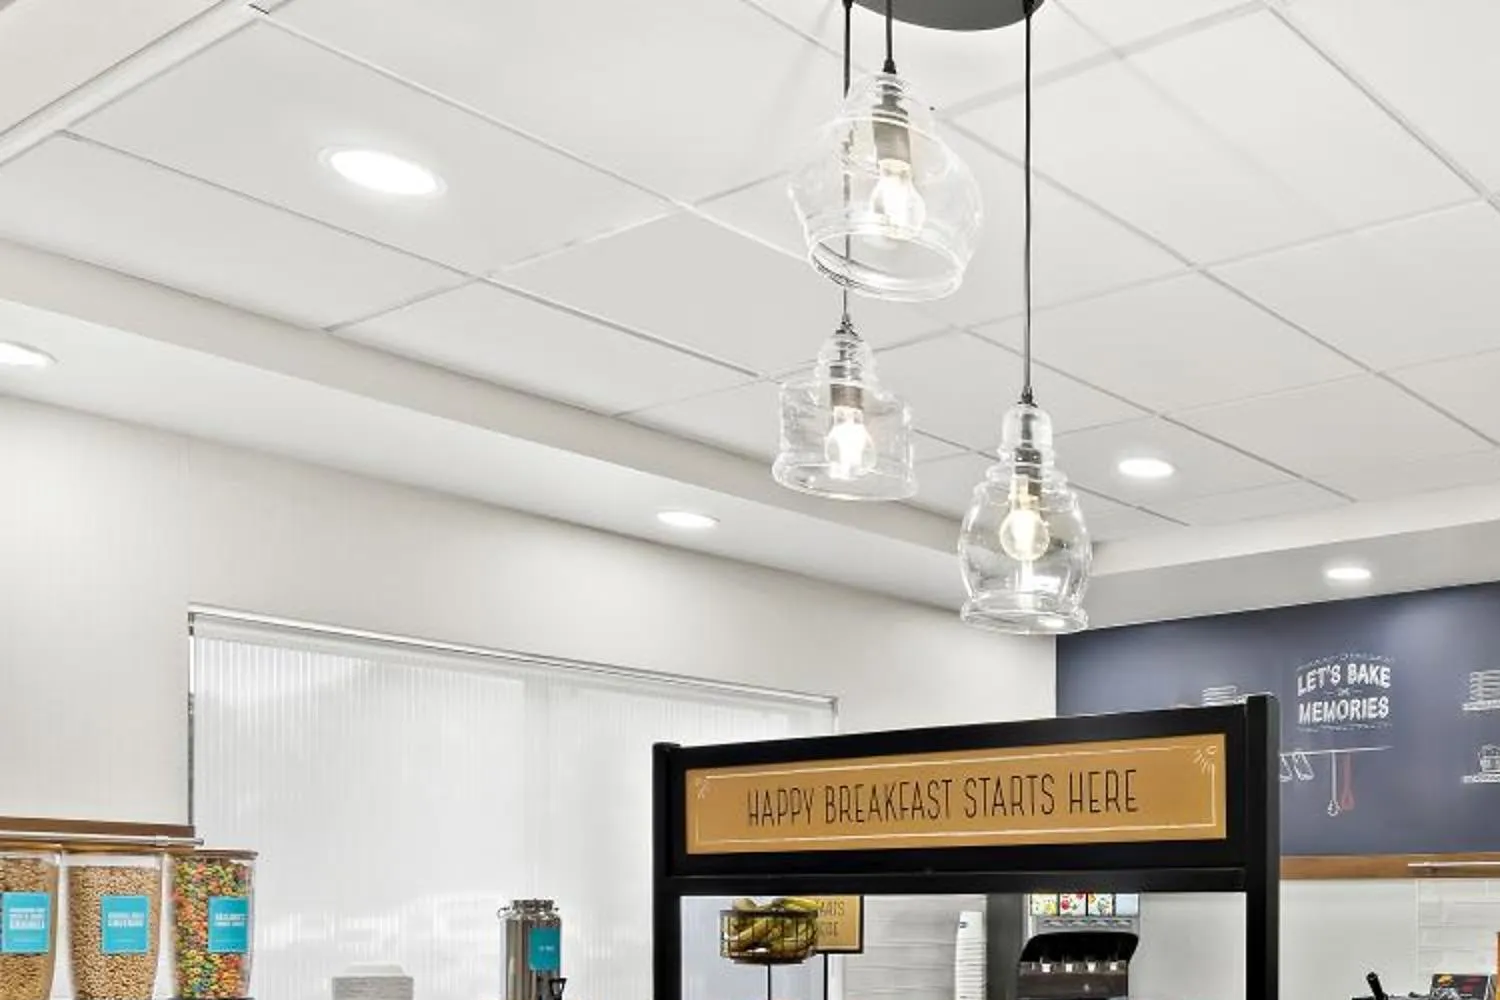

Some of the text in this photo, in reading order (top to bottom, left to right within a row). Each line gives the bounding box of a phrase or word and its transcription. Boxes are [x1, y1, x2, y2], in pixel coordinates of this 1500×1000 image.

[1297, 663, 1391, 697] LET'S BAKE
[1299, 696, 1389, 725] MEMORIES
[747, 769, 1139, 827] HAPPY BREAKFAST STARTS HERE
